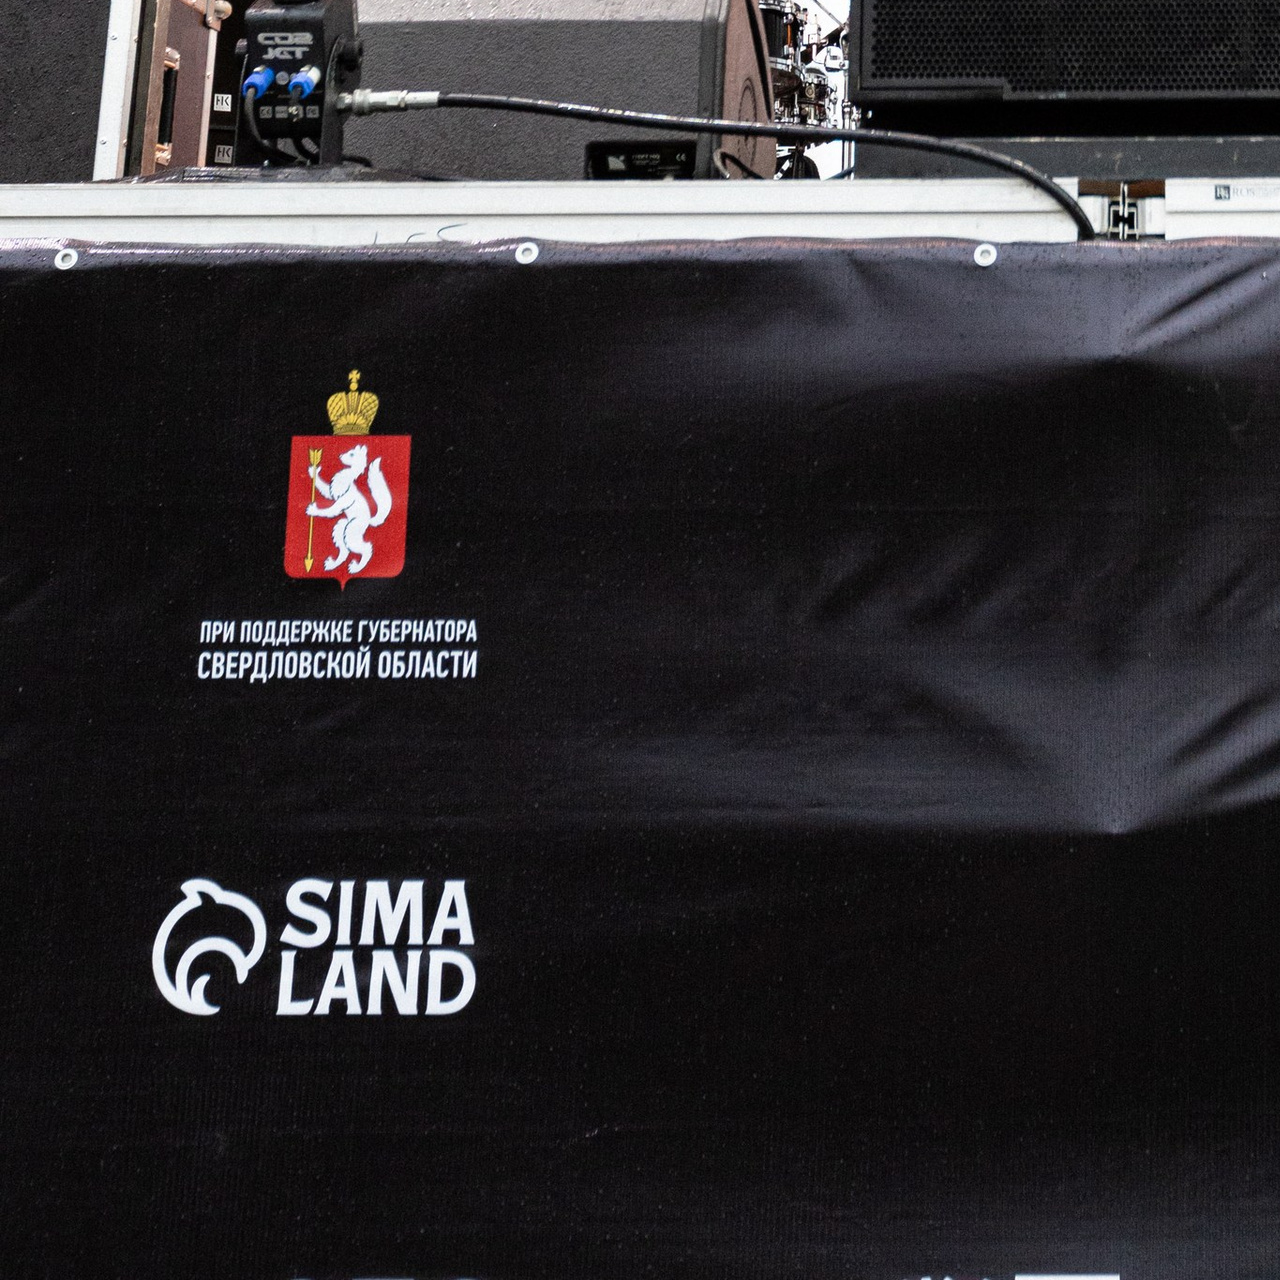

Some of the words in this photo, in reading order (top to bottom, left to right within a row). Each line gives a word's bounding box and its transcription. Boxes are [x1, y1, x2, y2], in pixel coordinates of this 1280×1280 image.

[200, 621, 235, 643] ПРИ
[240, 620, 353, 646] ПОДДЕРЖКЕ
[358, 620, 478, 643] ГУБЕРНАТОРА
[198, 645, 371, 683] СВЕРДЛОВСКОЙ
[377, 650, 478, 679] ОБЛАСТИ
[280, 879, 475, 949] SIMA
[276, 949, 477, 1016] LAND
